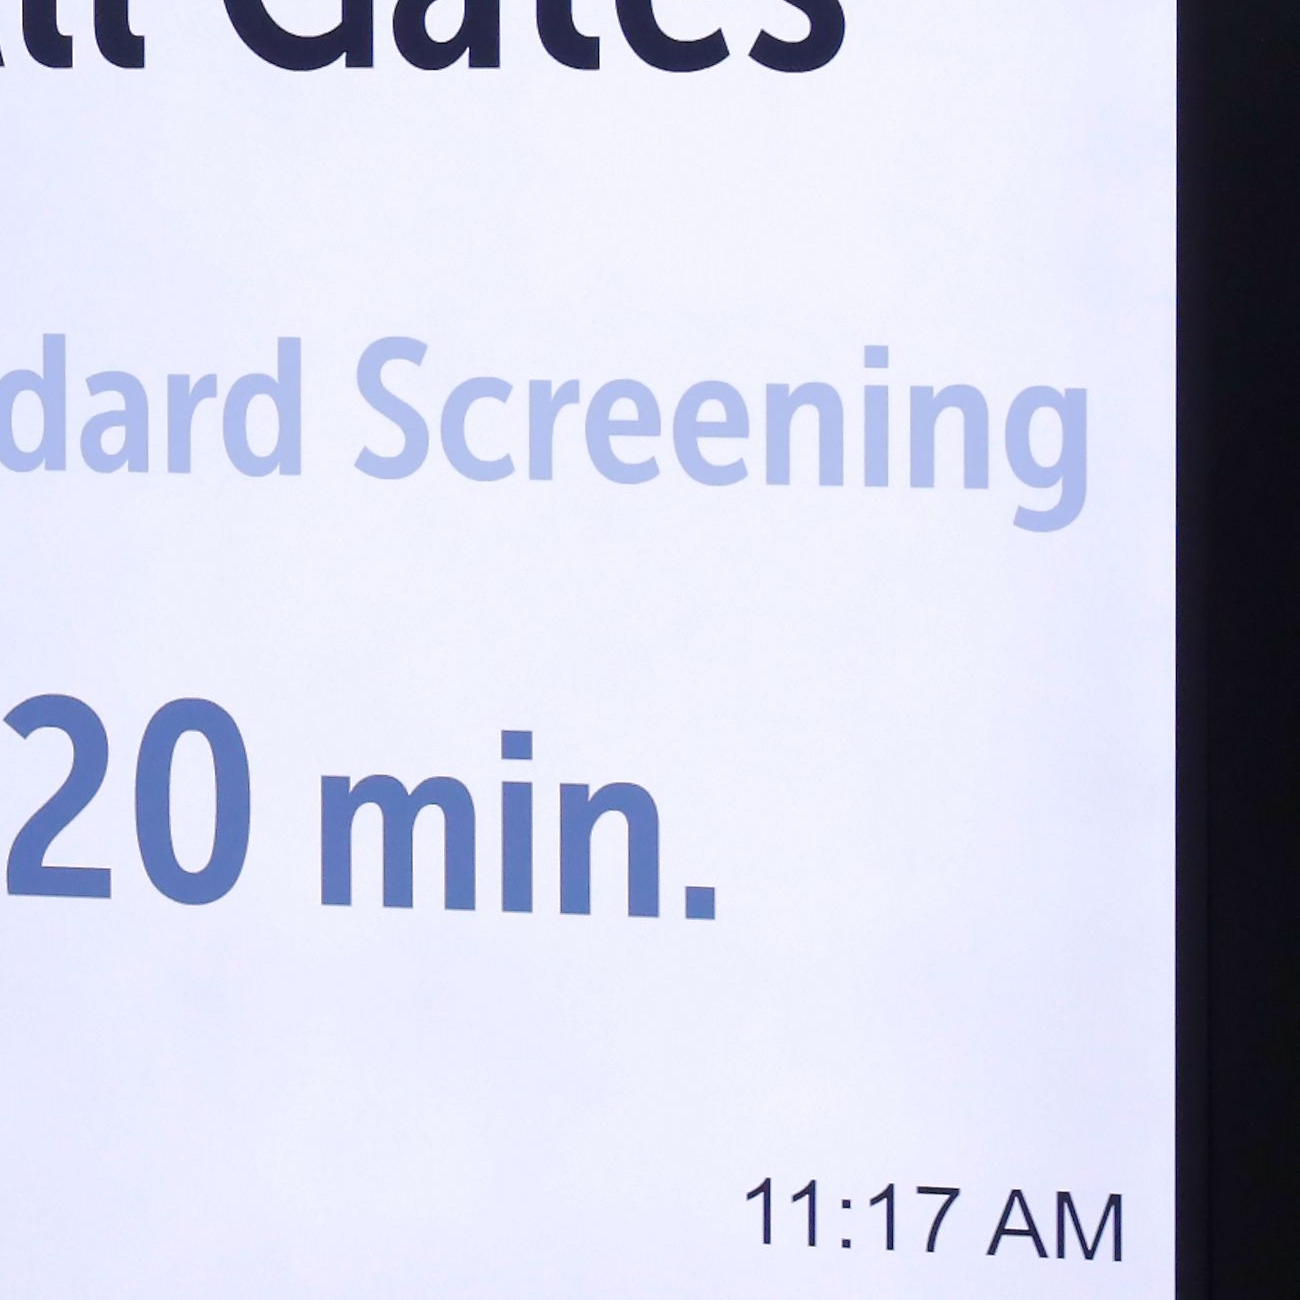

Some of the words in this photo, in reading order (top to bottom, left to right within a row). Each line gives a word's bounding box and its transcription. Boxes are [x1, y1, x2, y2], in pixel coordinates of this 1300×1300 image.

[353, 335, 1090, 535] Screening
[319, 728, 718, 922] min.
[745, 1176, 961, 1254] 11:17
[986, 1187, 1124, 1263] AM
